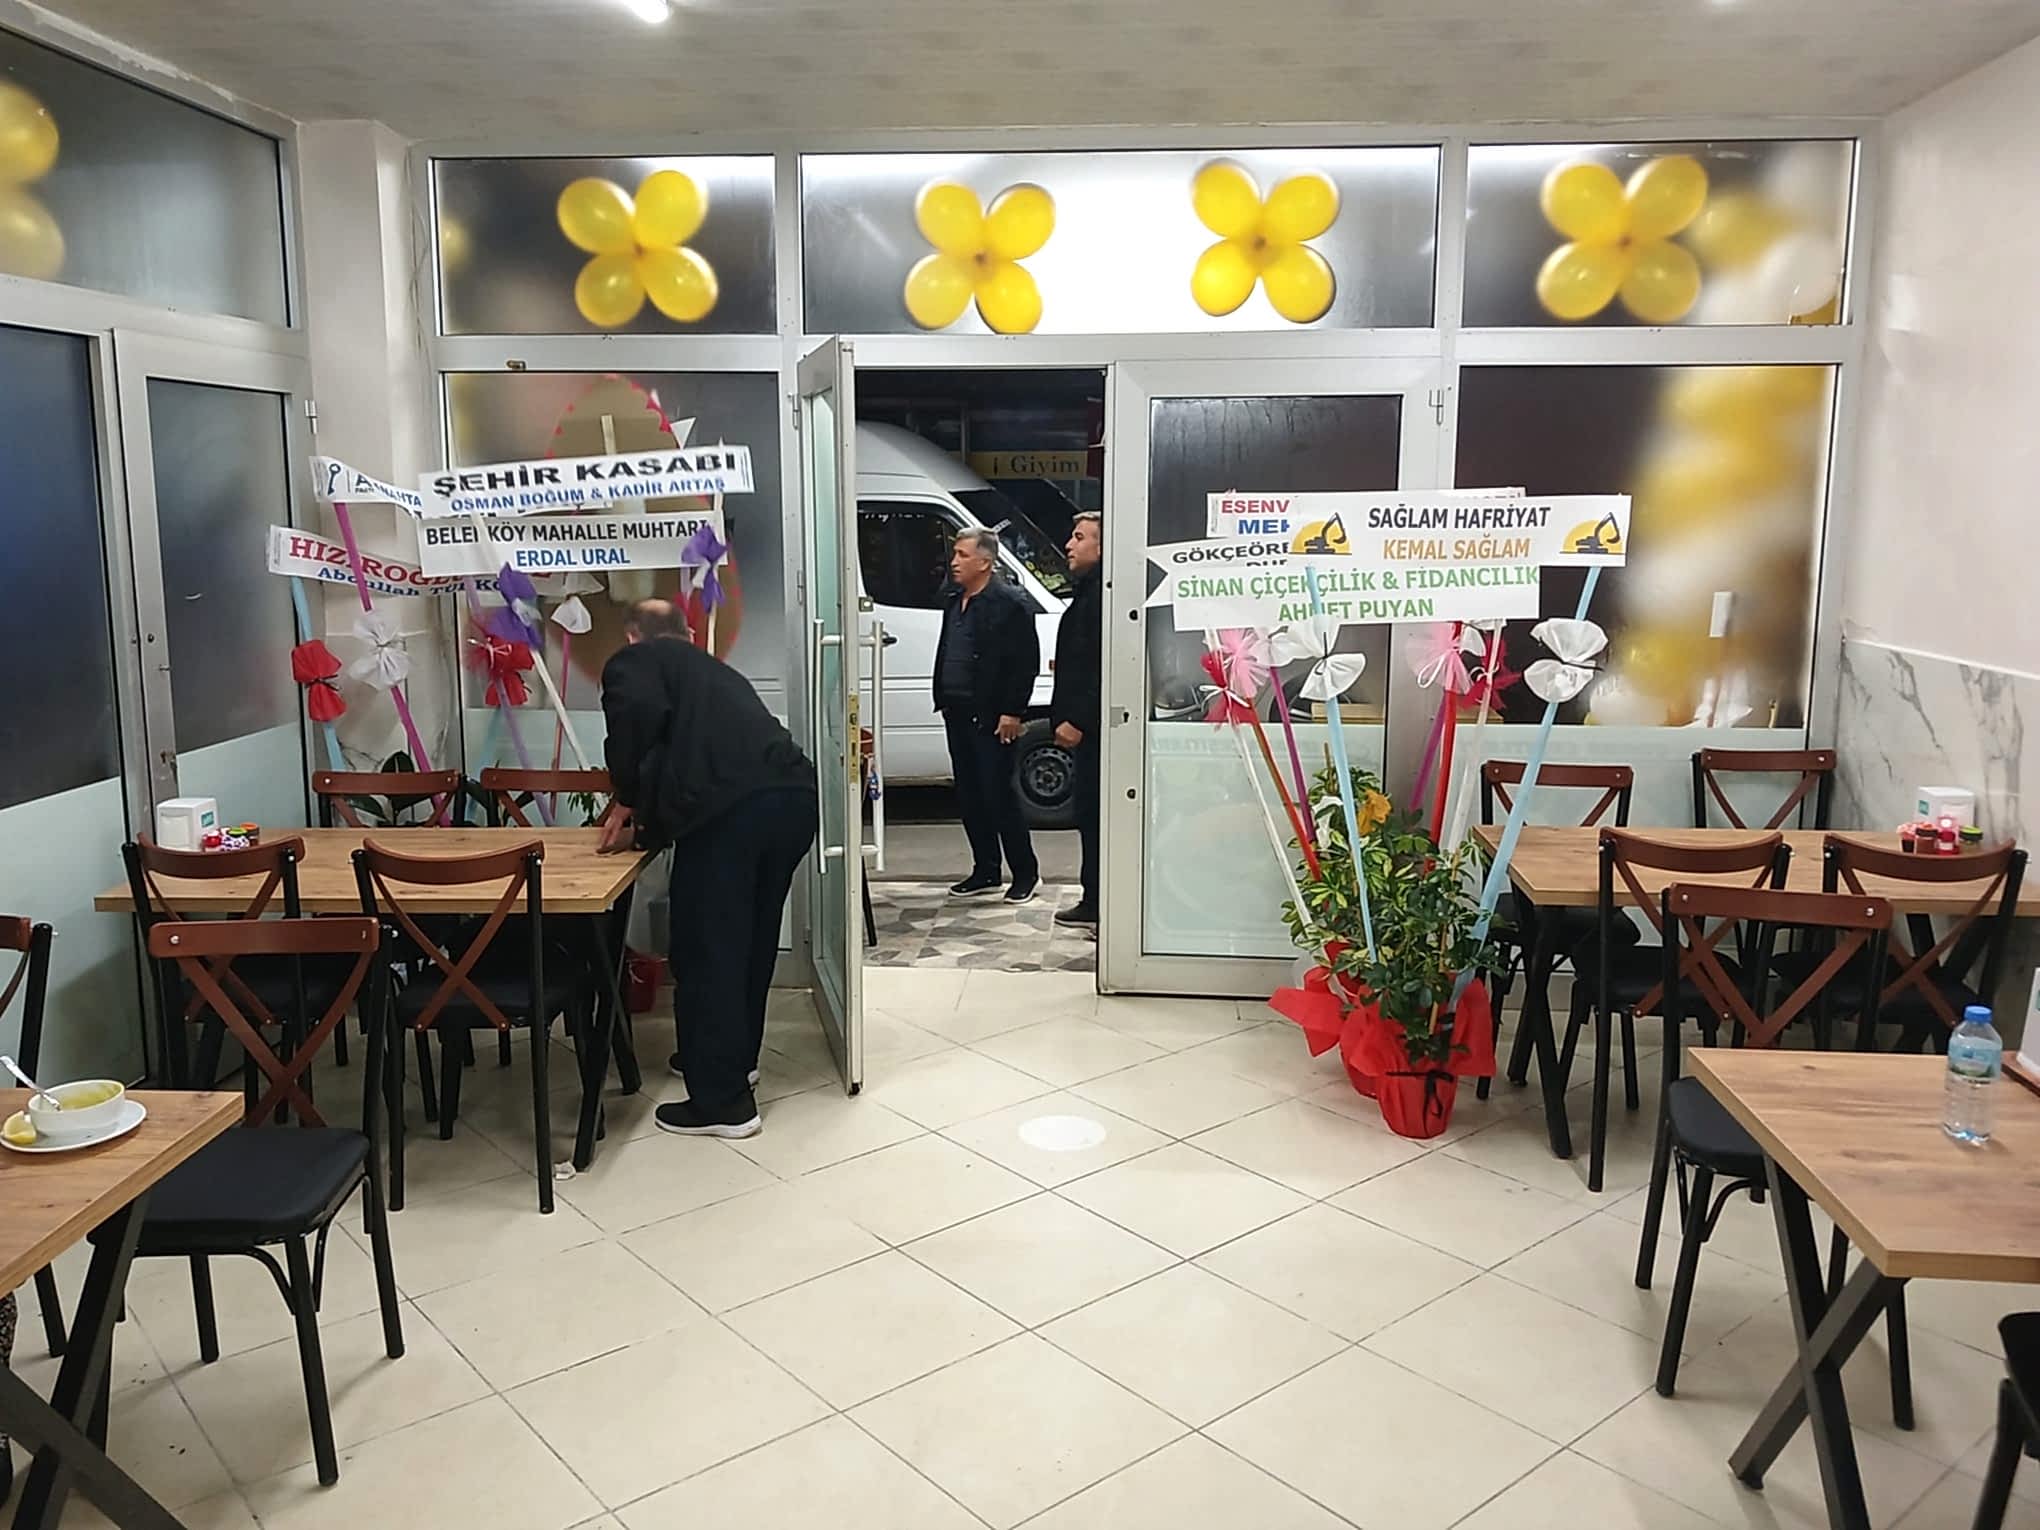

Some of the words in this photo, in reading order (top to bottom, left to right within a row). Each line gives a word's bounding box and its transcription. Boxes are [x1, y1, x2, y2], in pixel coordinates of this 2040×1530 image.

[433, 465, 561, 498] ŞEHİR
[576, 453, 736, 481] KASABI
[1010, 455, 1080, 476] Giyim
[451, 494, 515, 511] OSMAN
[519, 488, 585, 507] BOĞUM
[591, 489, 603, 500] &
[609, 480, 662, 499] KADİR
[1368, 504, 1449, 529] SAĞLAM
[1454, 504, 1551, 529] HAFRİYAT
[488, 522, 526, 542] KÖY
[532, 523, 618, 541] MAHALLE
[516, 550, 577, 567] ERDAL
[582, 548, 630, 565] URAL
[1383, 539, 1448, 560] KEMAL
[1453, 533, 1531, 560] SAĞLAM
[1178, 575, 1244, 598] SİNAN
[1382, 570, 1400, 590] &
[1406, 566, 1538, 589] FİDANCILIK
[1359, 598, 1434, 619] PUYAN
